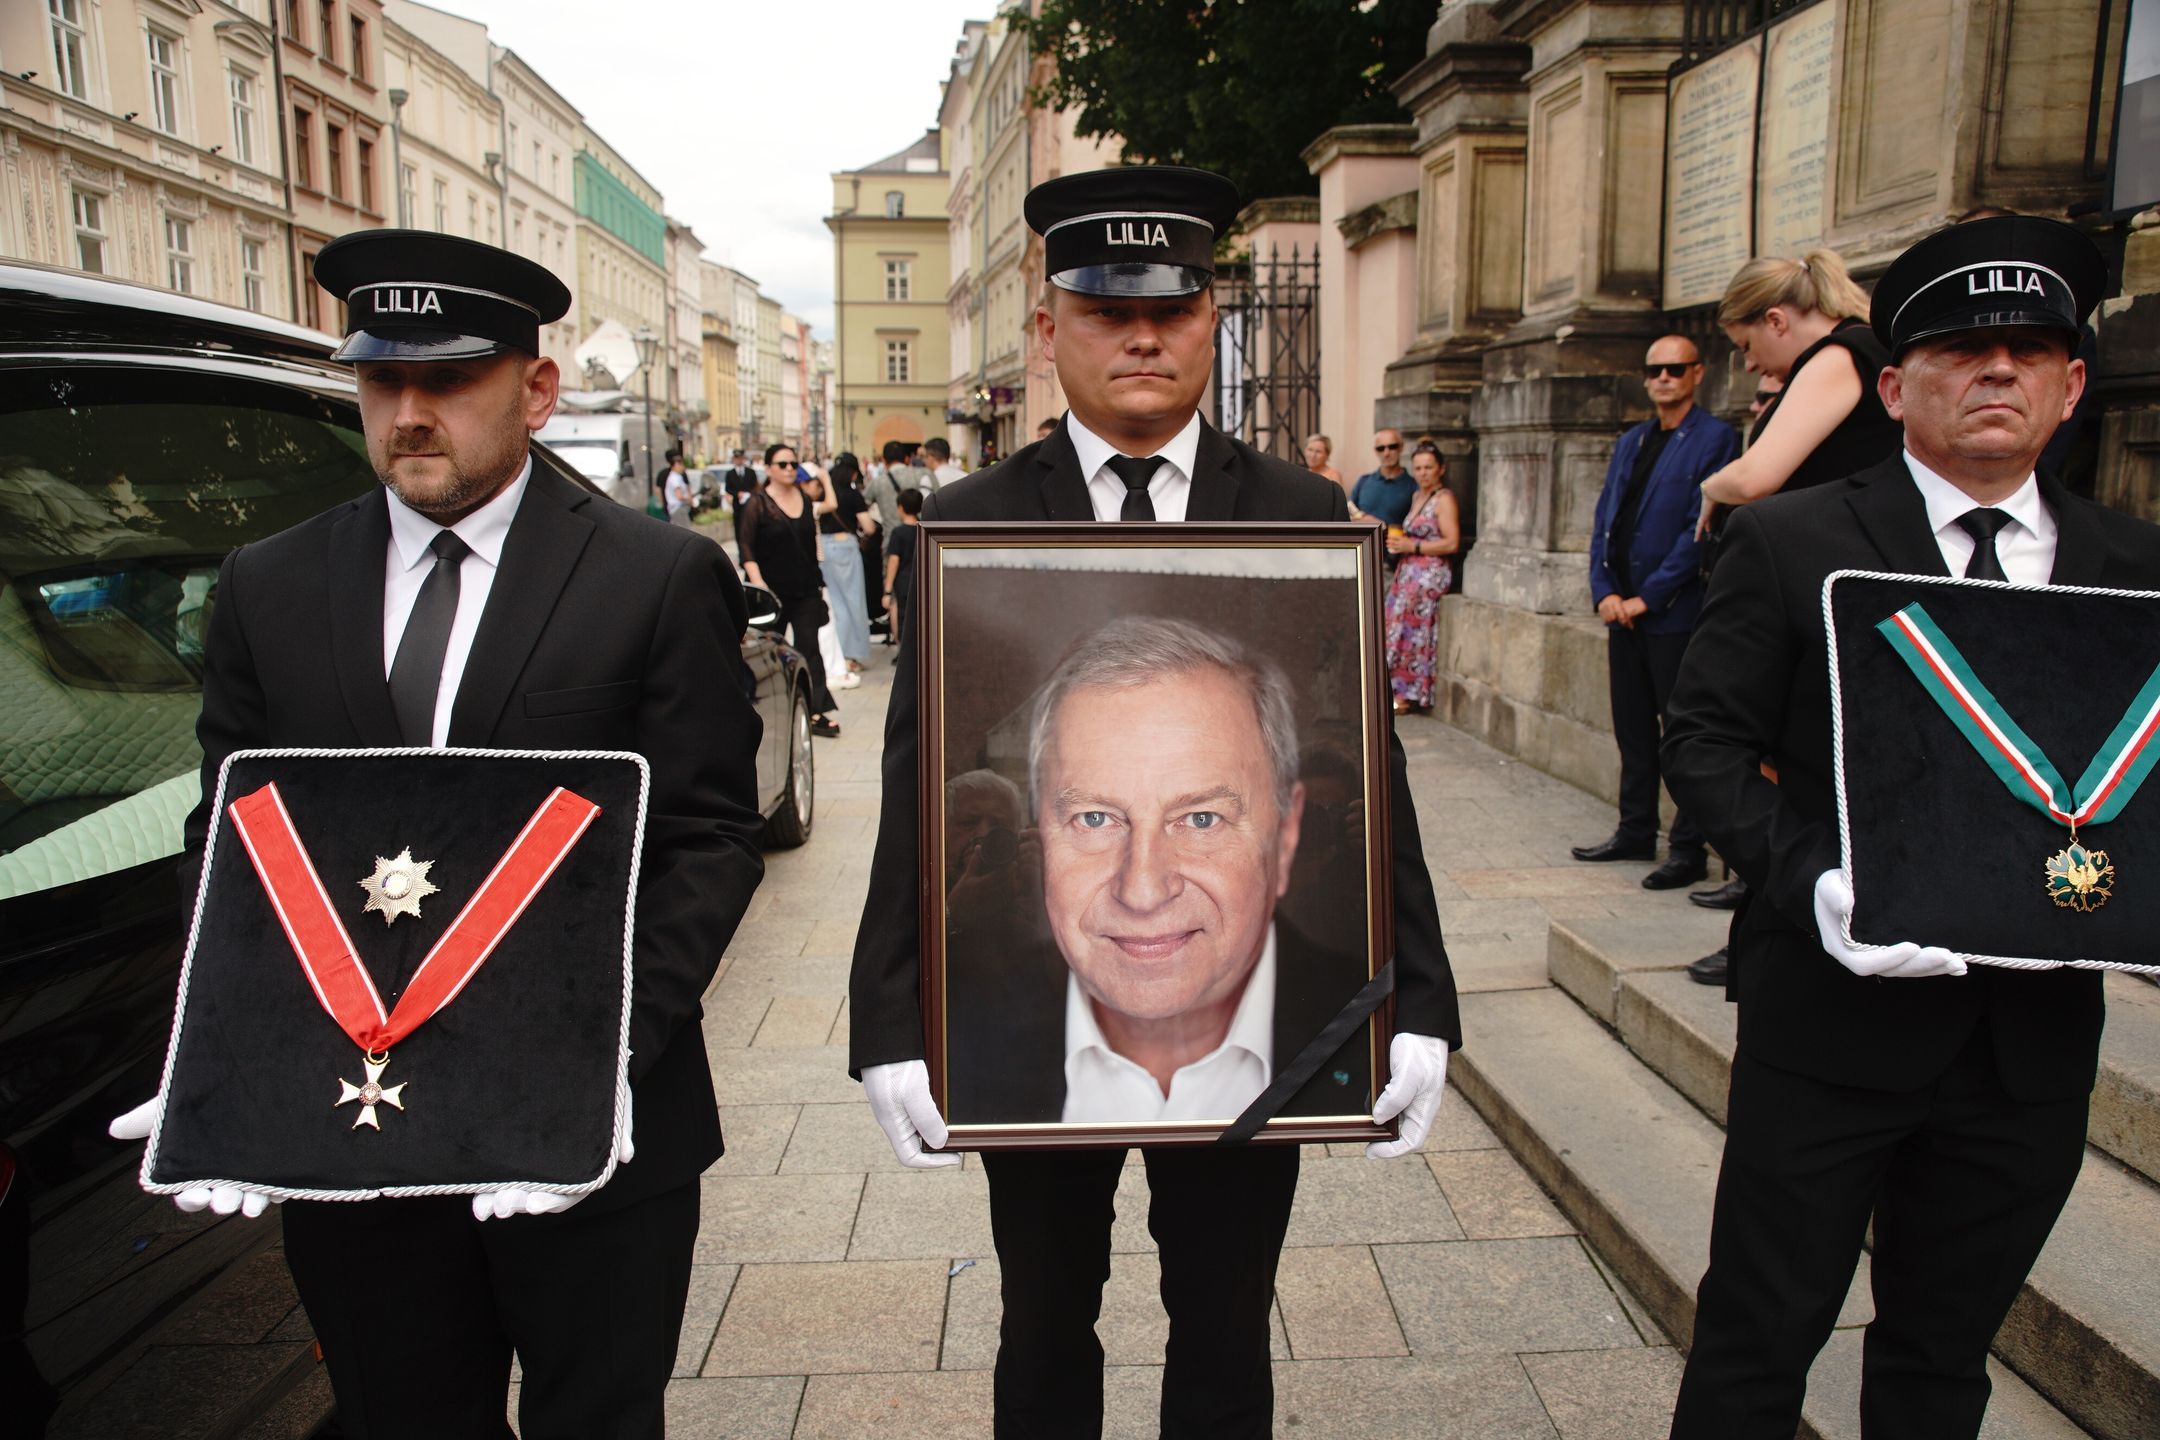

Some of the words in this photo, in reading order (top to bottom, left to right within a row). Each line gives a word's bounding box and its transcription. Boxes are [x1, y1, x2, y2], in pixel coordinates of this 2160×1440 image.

[1106, 222, 1170, 248] LILIA
[1968, 269, 2045, 297] LILIA
[373, 289, 443, 315] LILIA
